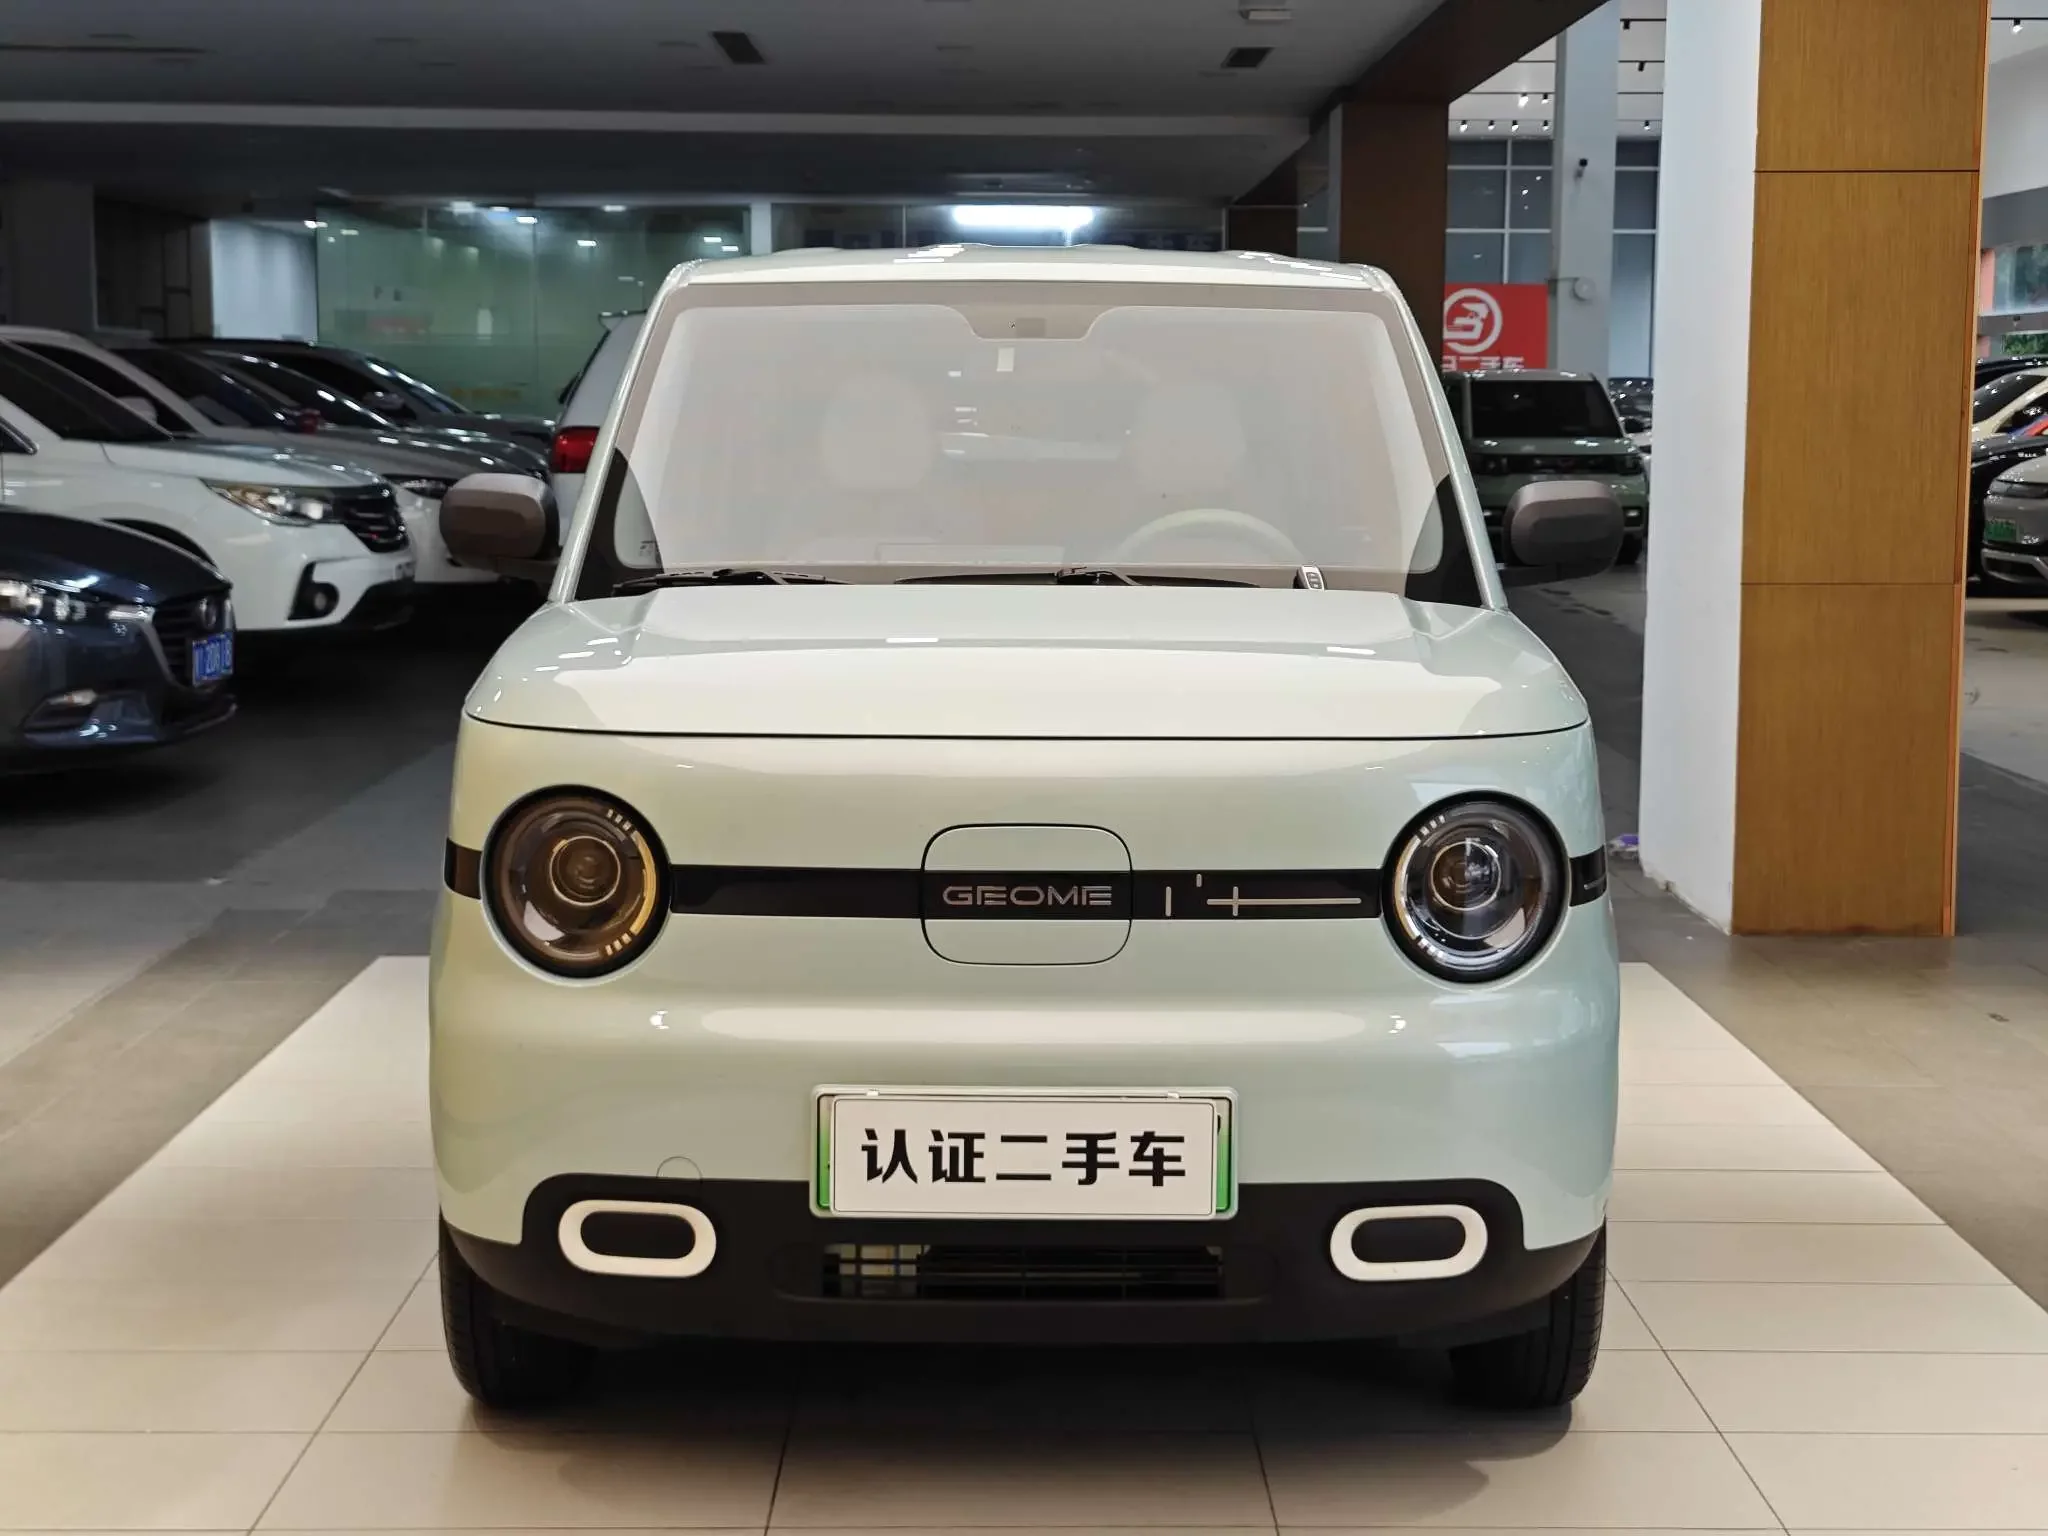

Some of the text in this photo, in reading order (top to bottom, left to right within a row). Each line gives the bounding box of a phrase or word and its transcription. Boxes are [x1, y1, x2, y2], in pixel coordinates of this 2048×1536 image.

[942, 885, 1113, 906] GEOME
[861, 1128, 1186, 1187] 认证二手车
